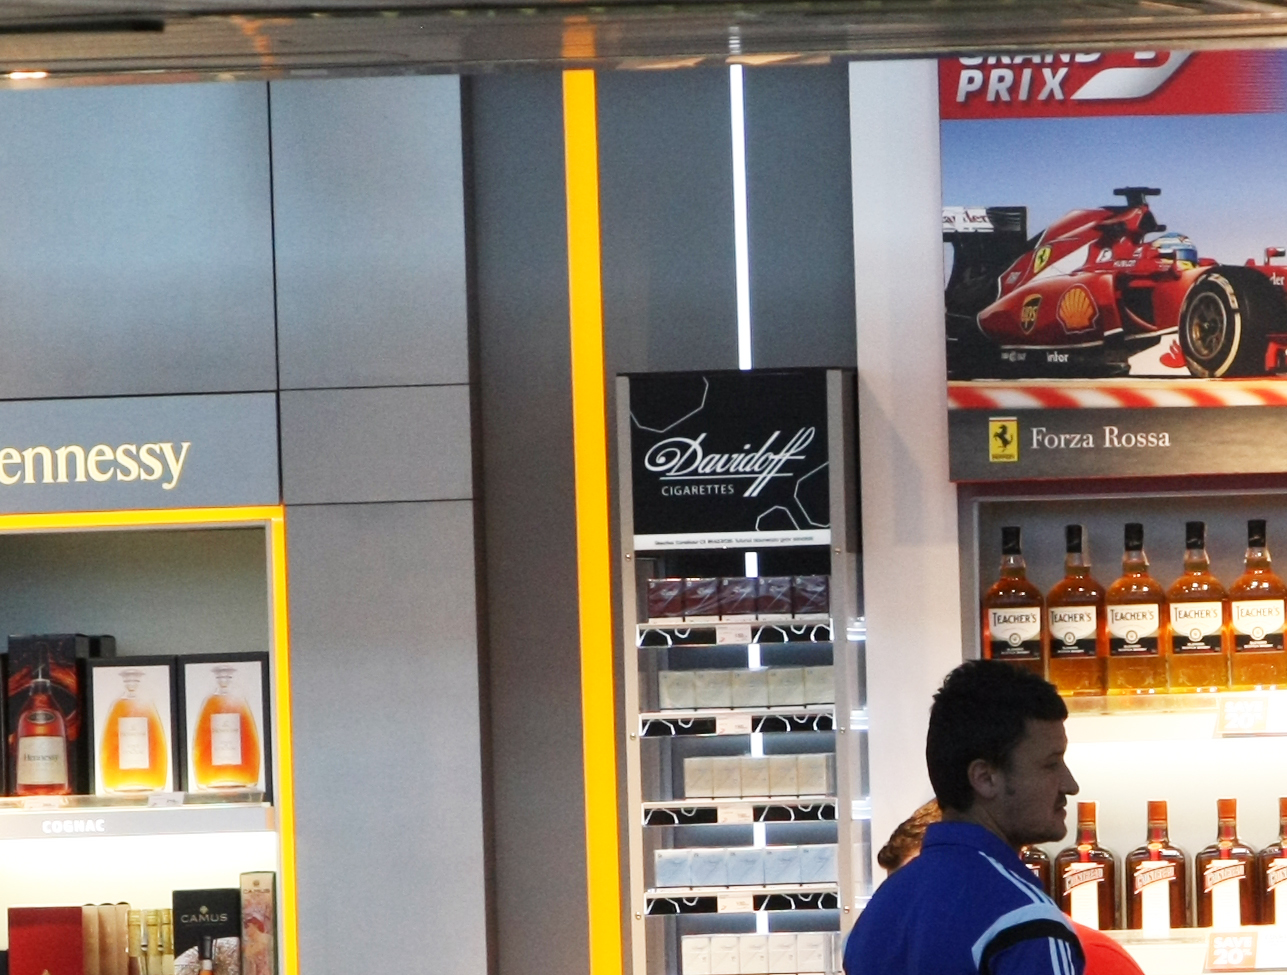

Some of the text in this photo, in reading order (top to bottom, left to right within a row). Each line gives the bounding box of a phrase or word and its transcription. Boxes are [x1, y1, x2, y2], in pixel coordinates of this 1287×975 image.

[956, 67, 1069, 102] PRIX
[1030, 425, 1171, 449] Forza Rossa
[0, 441, 191, 490] ennessy
[644, 426, 815, 498] Davidoff
[661, 483, 735, 497] CIGARETTES
[42, 819, 105, 834] COGNAC
[180, 913, 229, 923] CAMUS
[1213, 936, 1253, 949] SAVE
